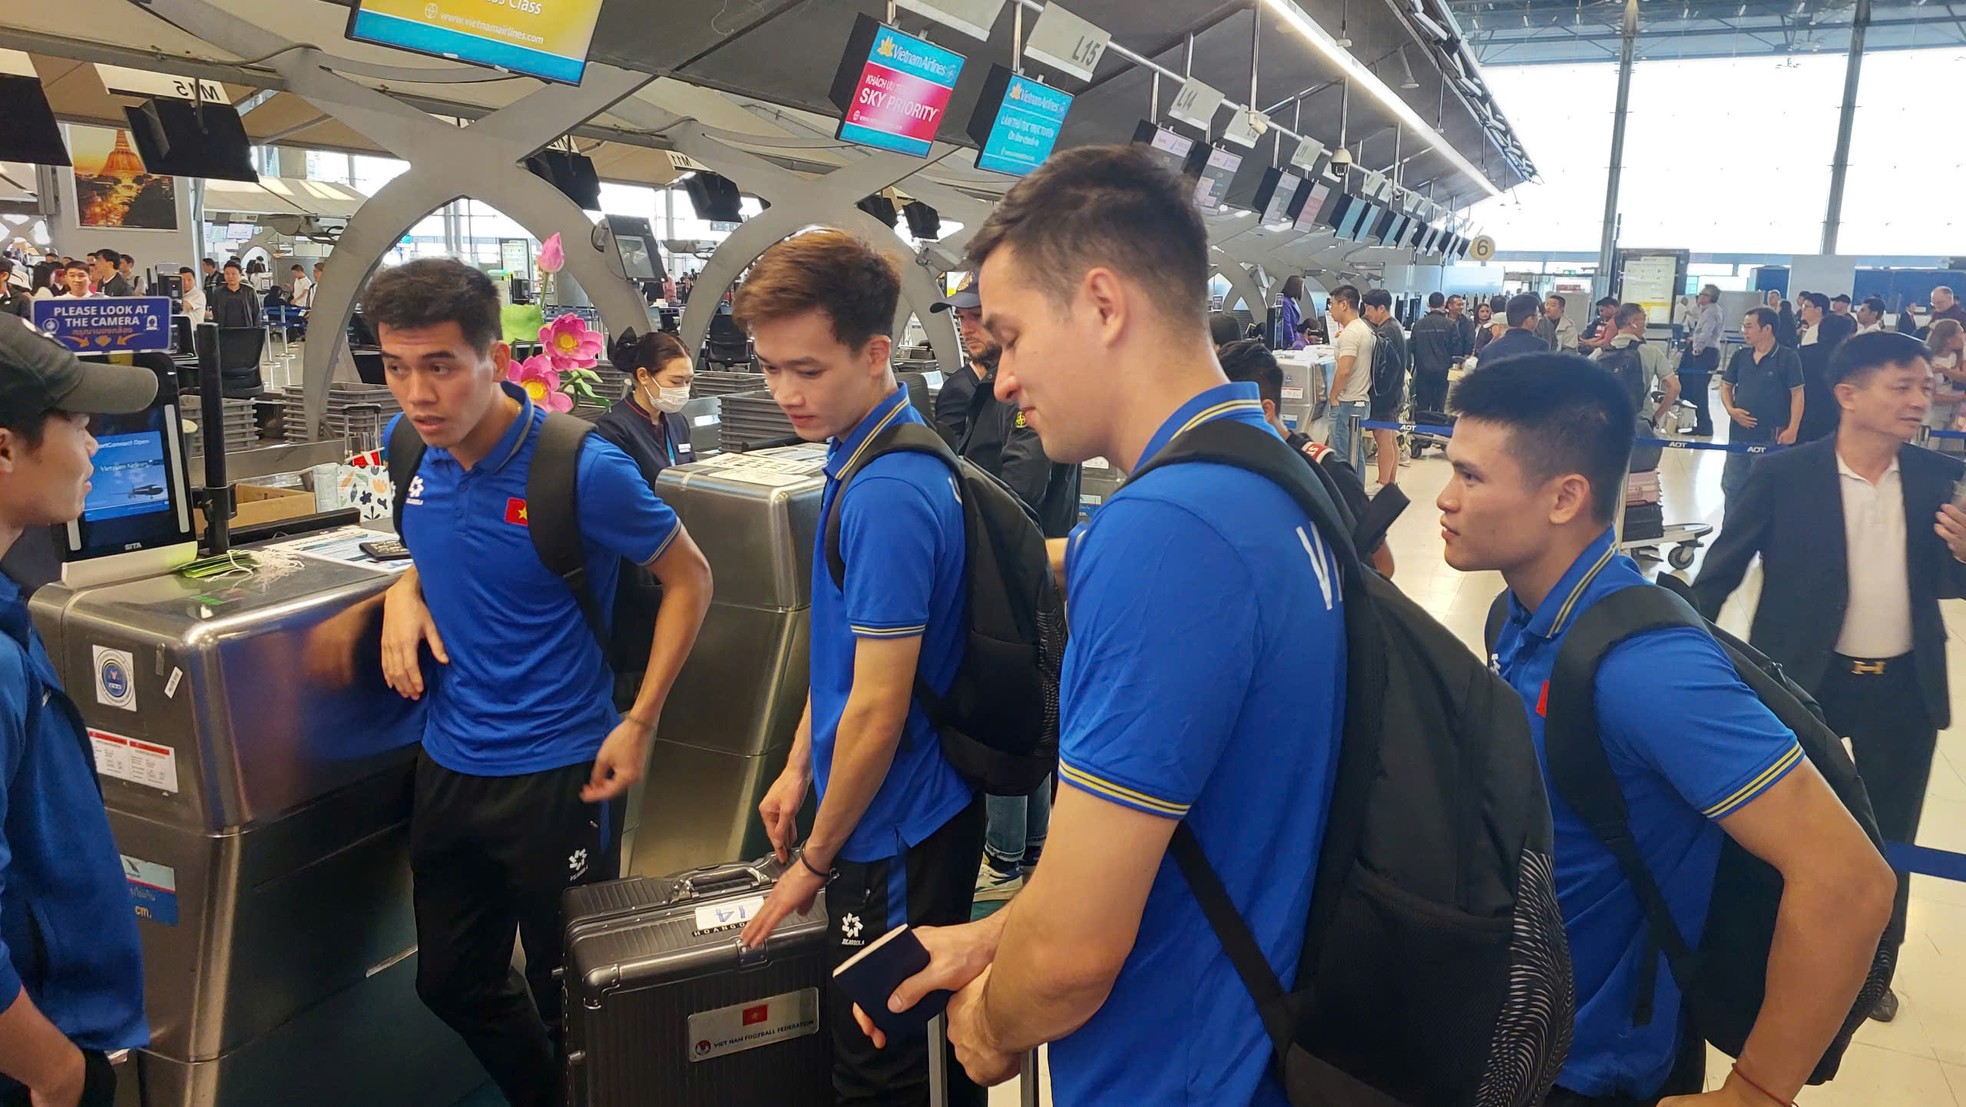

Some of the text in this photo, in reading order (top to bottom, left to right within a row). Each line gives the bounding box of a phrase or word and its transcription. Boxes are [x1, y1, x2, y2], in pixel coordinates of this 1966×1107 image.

[440, 13, 544, 44] www.vietnamairlines.com
[1072, 35, 1101, 67] L15
[859, 87, 887, 108] SKY
[886, 95, 938, 122] PRIORITY
[1176, 87, 1198, 111] L14
[1477, 239, 1489, 256] 6
[54, 305, 150, 316] PLEASE LOOK AT
[65, 316, 140, 327] THE CAMERA
[1399, 423, 1418, 431] AOT
[713, 1020, 814, 1048] VIET NAM FOOTBALL FEDERATION
